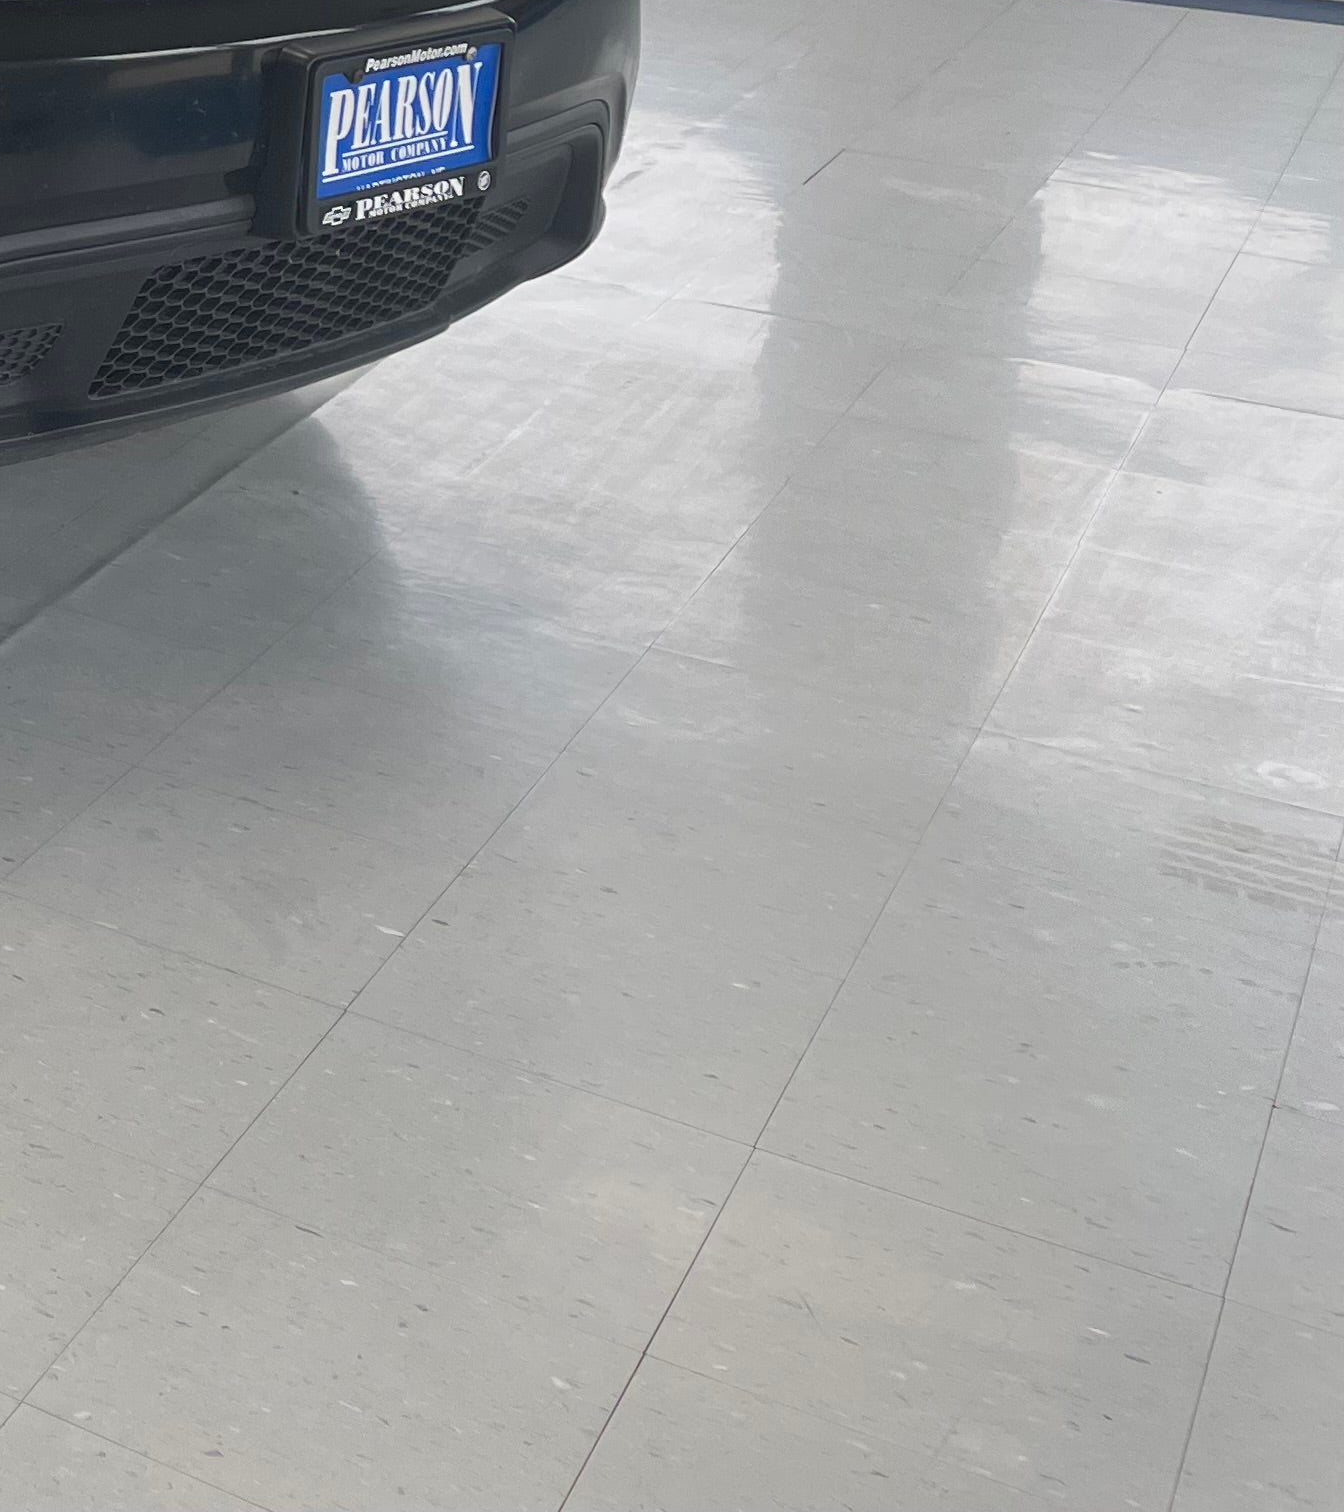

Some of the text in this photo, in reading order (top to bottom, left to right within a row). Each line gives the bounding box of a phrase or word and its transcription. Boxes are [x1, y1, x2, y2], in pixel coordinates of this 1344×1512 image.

[365, 43, 469, 73] PearsonMotor.com
[322, 61, 483, 176] PEARSON
[341, 137, 448, 173] MOTOR COMPANY
[355, 176, 466, 221] PEARSON
